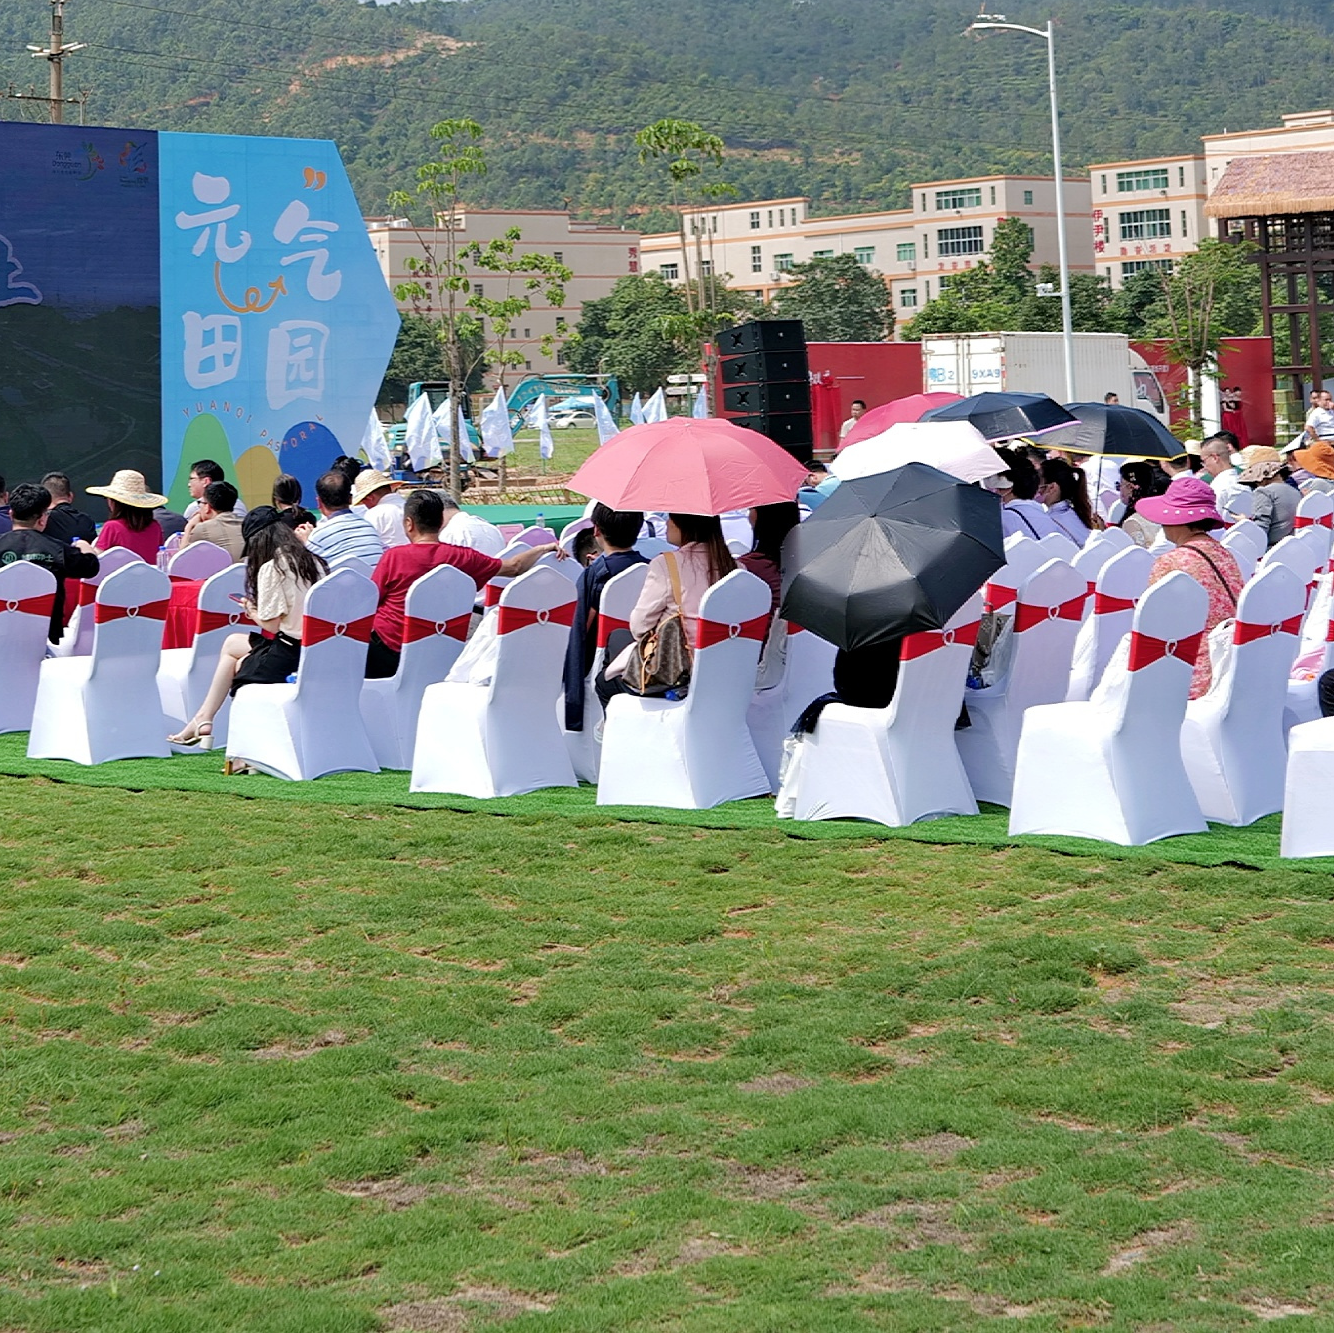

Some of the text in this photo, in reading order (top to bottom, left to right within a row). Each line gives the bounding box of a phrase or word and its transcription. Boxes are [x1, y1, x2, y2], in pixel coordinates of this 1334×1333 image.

[176, 170, 343, 301] 元气
[182, 310, 331, 410] 田园
[182, 400, 324, 452] YUANQI PASTORAL
